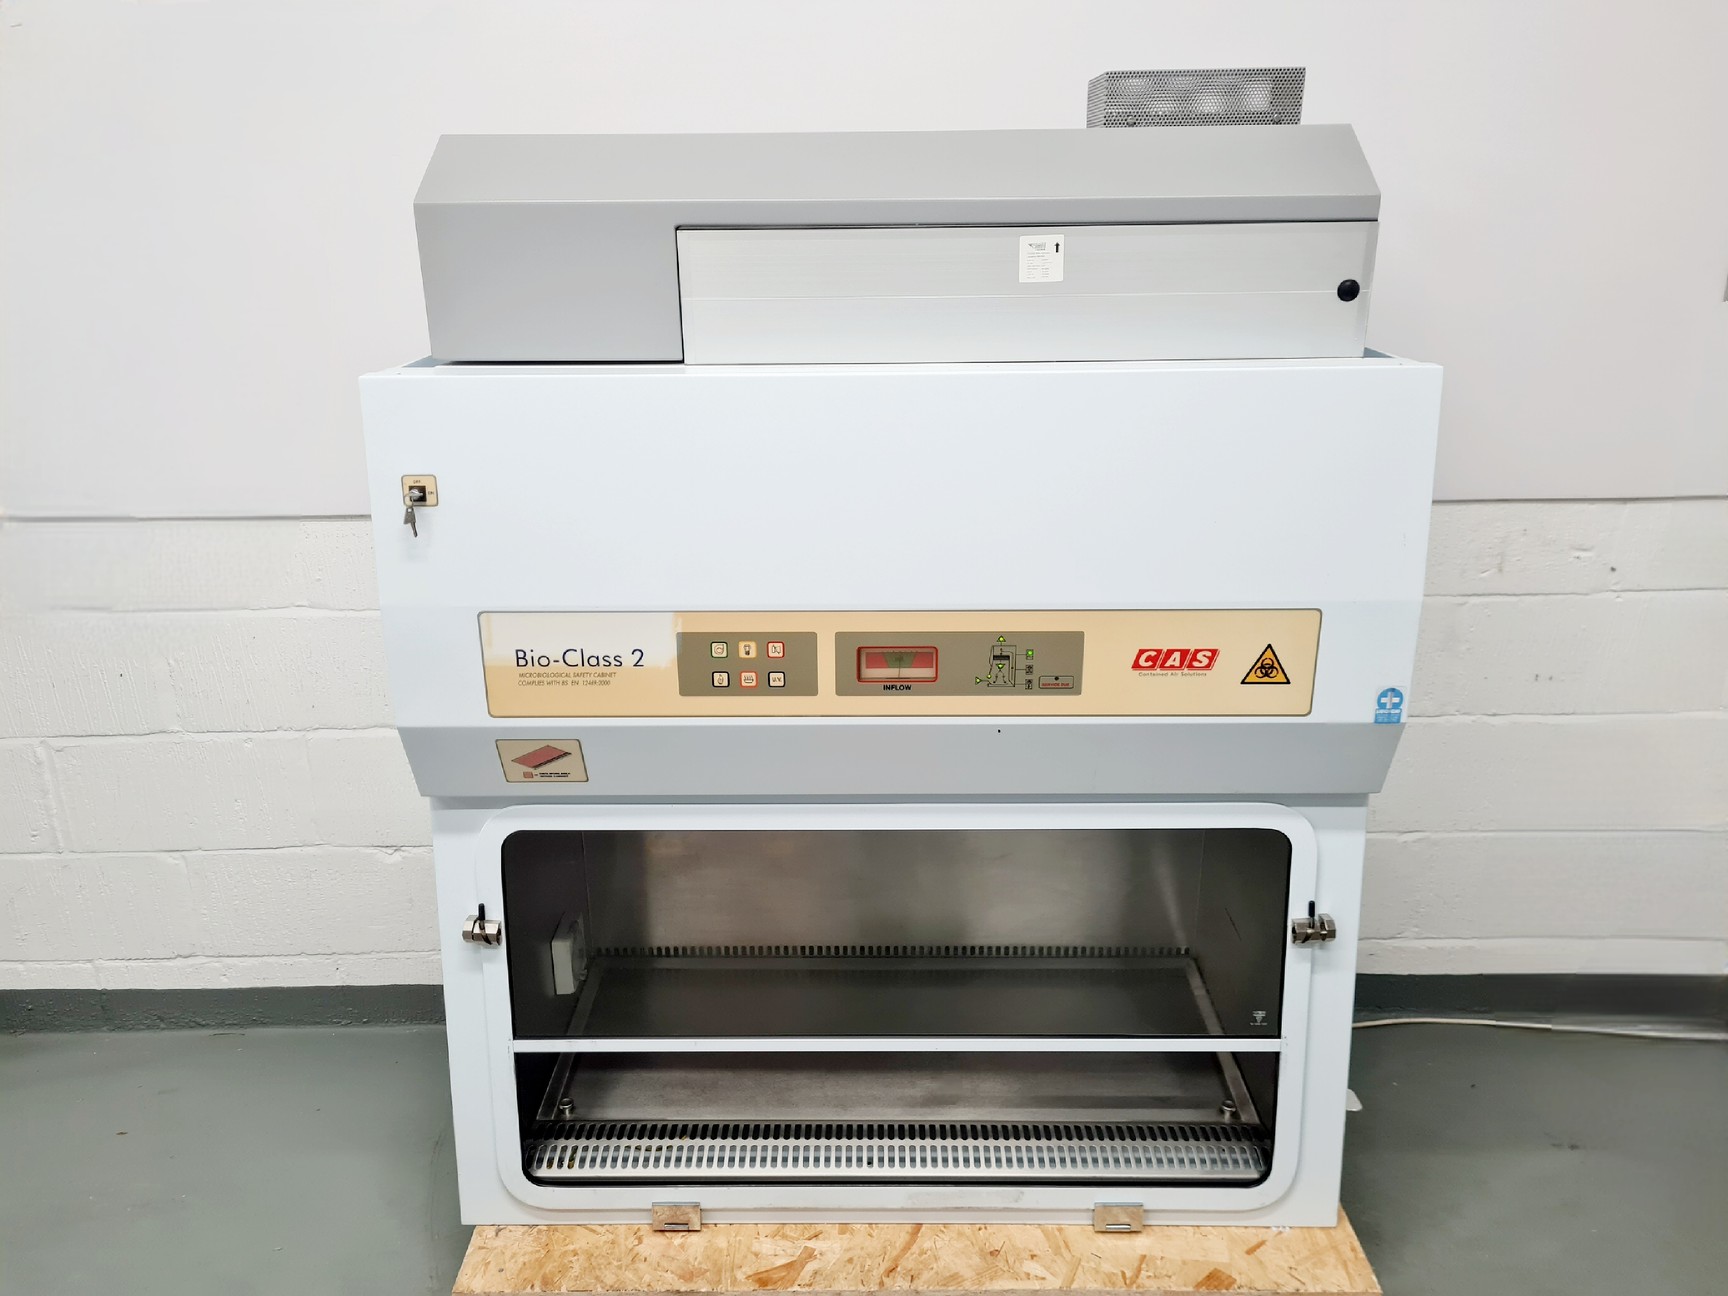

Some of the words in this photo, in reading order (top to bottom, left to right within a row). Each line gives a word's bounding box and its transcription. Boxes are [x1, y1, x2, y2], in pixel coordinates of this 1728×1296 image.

[515, 648, 623, 667] Bio-Class
[631, 648, 645, 667] 2
[1138, 650, 1213, 668] CAS
